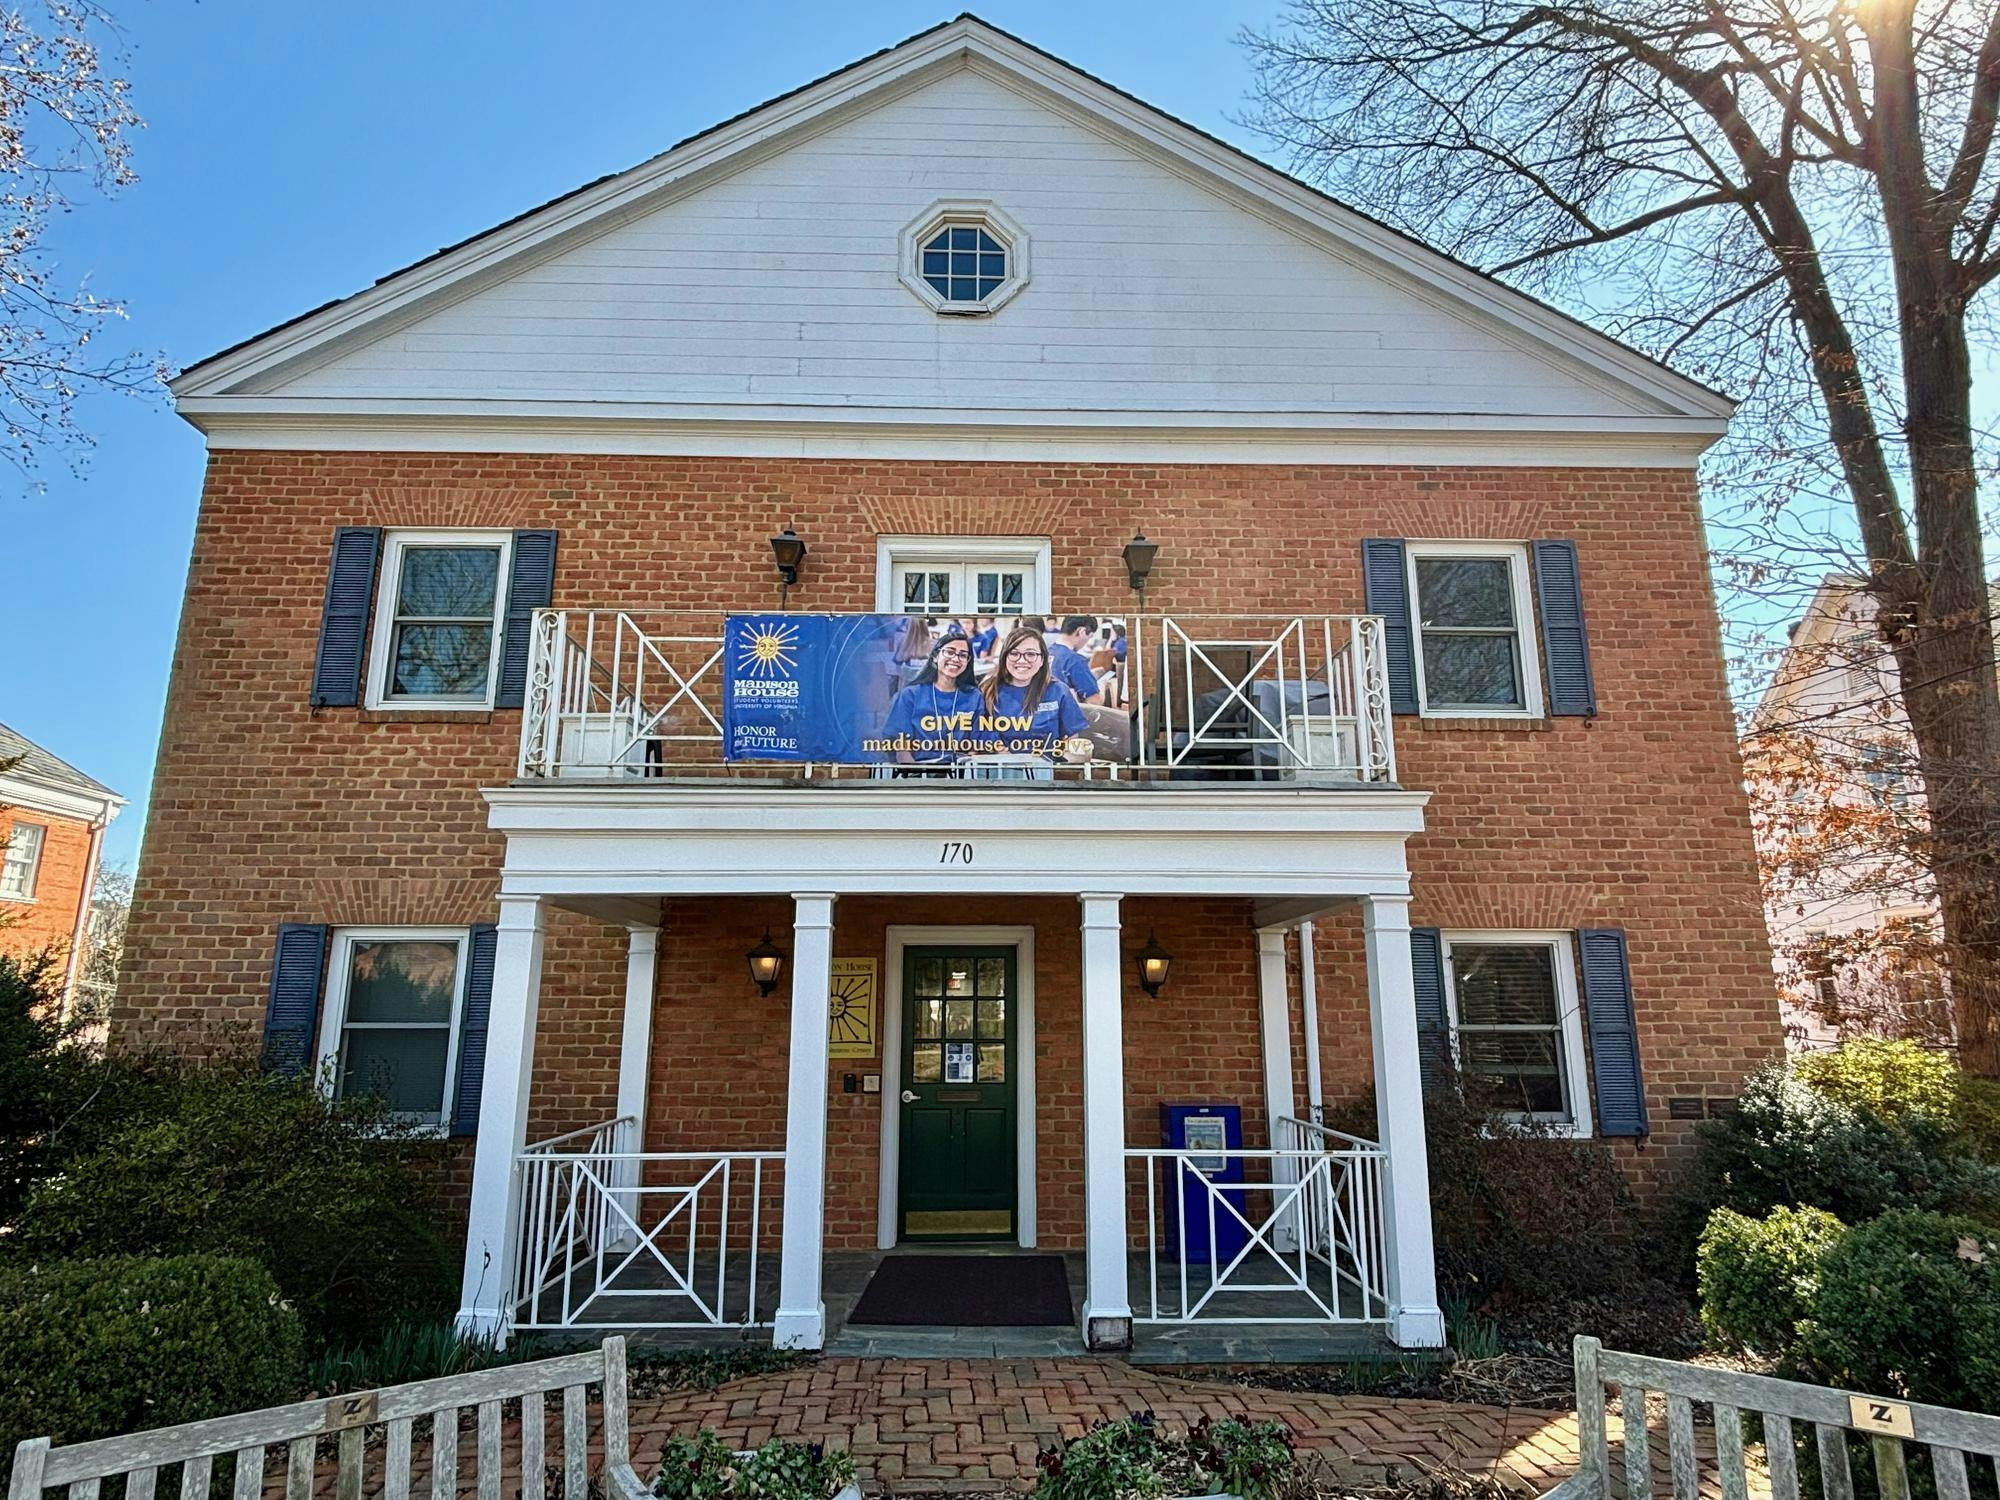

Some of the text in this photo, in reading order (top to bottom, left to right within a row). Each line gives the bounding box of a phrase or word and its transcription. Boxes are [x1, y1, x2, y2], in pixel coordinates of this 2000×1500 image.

[734, 725, 777, 736] HONOR
[920, 715, 1034, 732] GIVE NOW
[743, 736, 798, 749] FUTURE
[862, 733, 1093, 757] madisonhouse.org/give
[940, 842, 974, 865] 170
[1869, 1403, 1893, 1423] Z
